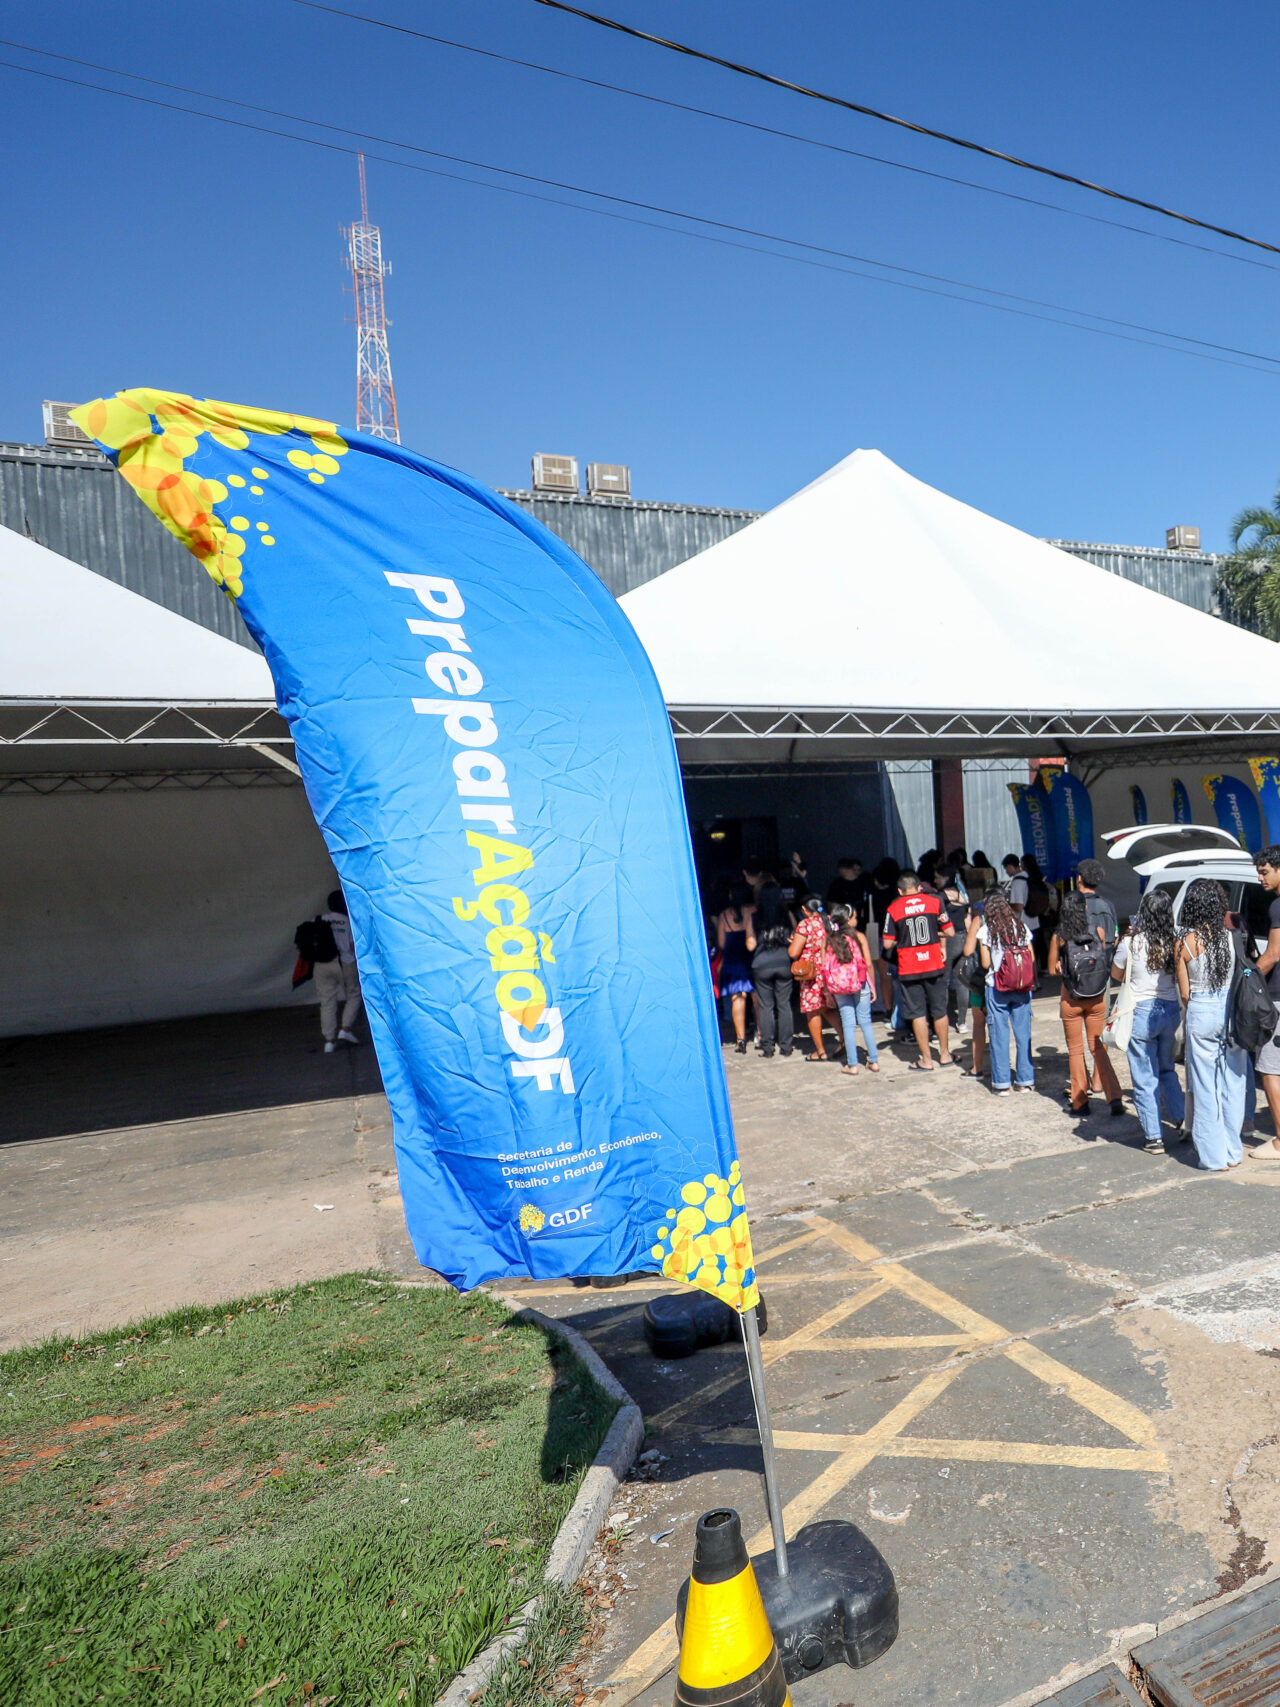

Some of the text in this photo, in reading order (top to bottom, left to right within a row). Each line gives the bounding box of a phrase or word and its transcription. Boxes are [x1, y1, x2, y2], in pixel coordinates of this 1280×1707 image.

[383, 571, 576, 1095] PreparAçãoDF
[1025, 794, 1048, 867] RENOVADF
[905, 915, 931, 947] 10
[497, 1140, 573, 1164] Secetaria de
[501, 1131, 662, 1177] Deenvolvimento Econômico,
[505, 1160, 604, 1190] Tbalho e Renda
[549, 1202, 593, 1228] GDF
